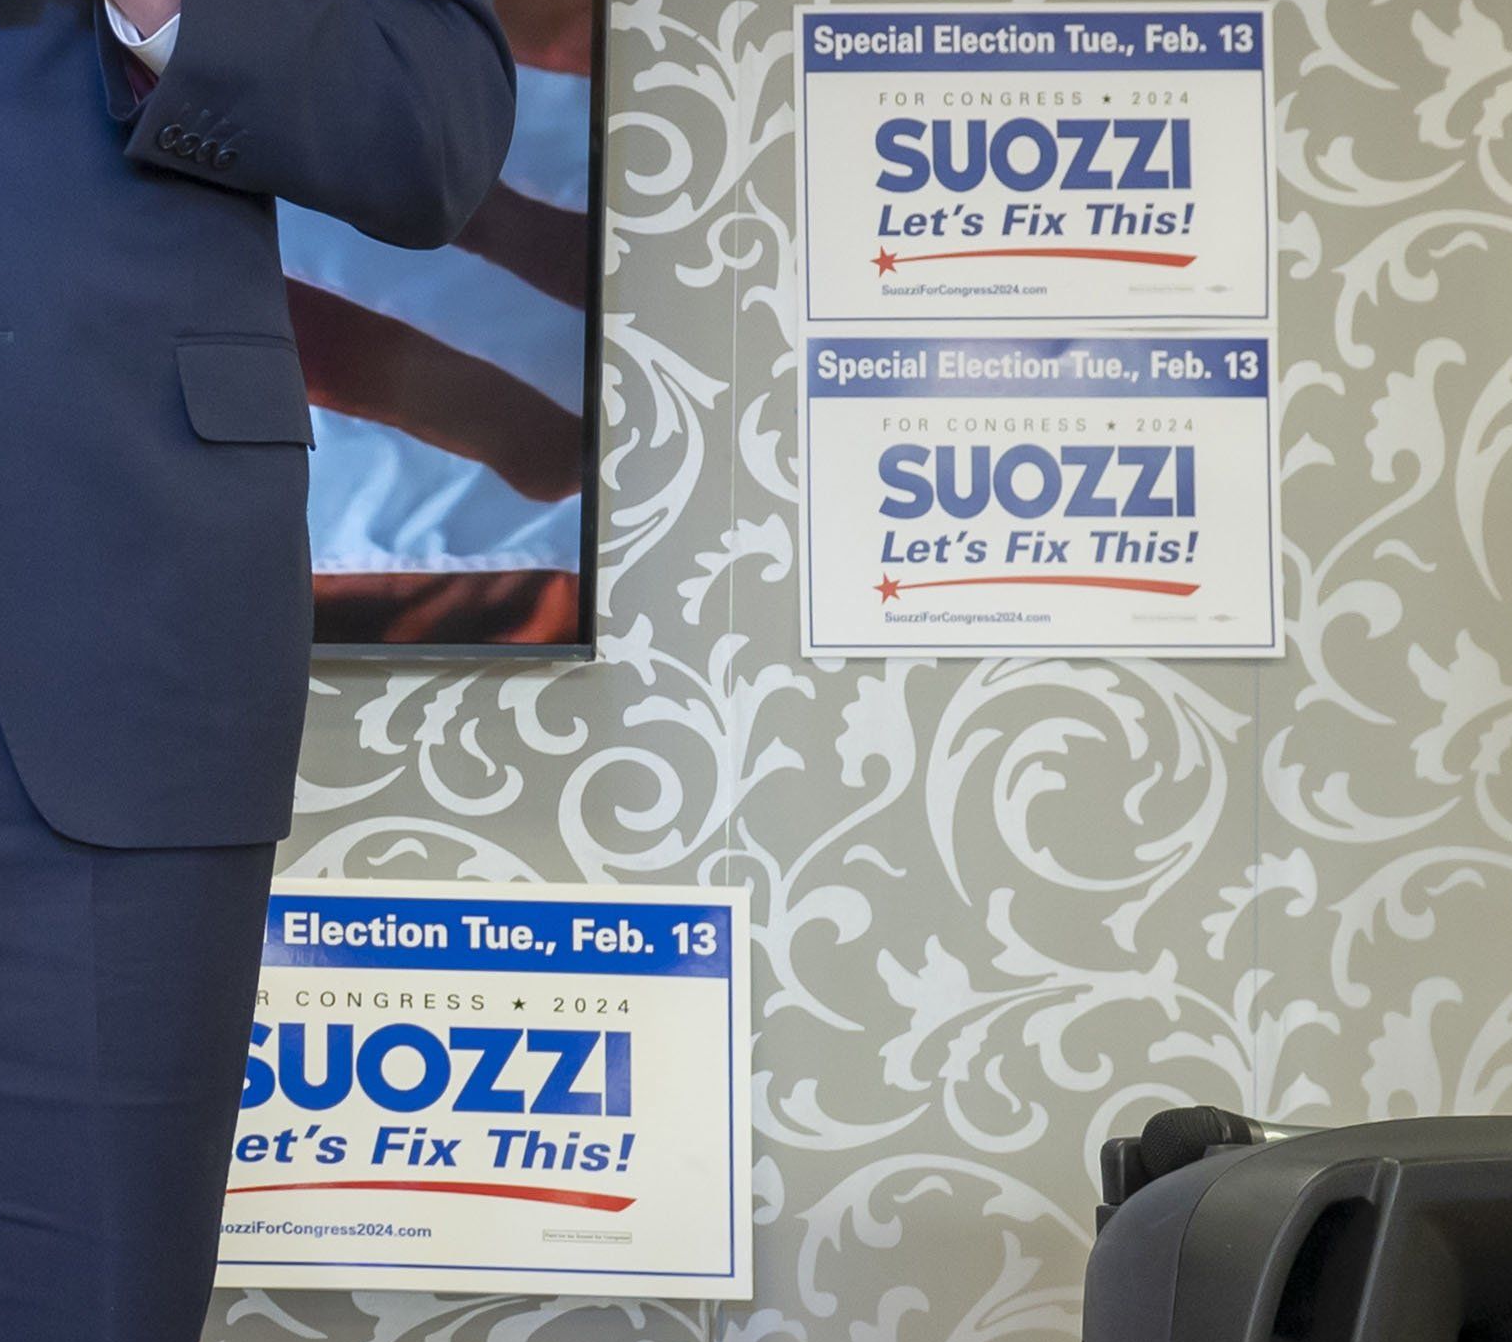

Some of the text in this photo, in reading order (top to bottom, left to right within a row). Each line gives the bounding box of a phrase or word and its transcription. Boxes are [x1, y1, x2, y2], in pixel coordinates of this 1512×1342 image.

[815, 24, 1253, 60] Special Election Tue., Feb. 13
[880, 91, 1188, 106] FOR CONGRESS 2024
[875, 118, 1191, 193] SUOZZI
[878, 203, 1194, 236] Let's Fix This!
[882, 284, 1047, 297] SuozziForCongress2024.com
[818, 350, 1258, 385] Special Election Tue., Feb. 13
[883, 418, 1192, 432] FOR CONGRESS 2024
[879, 444, 1195, 519] SUOZZI
[881, 531, 1198, 563] Let's Fix This!
[284, 912, 447, 949] Election
[462, 916, 556, 955] Tue.,
[573, 919, 654, 953] Feb.
[672, 923, 717, 956] 13
[296, 991, 632, 1013] CONGRESS 2024
[239, 1022, 631, 1117] SUOZZI
[235, 1122, 635, 1171] et's Fix This!
